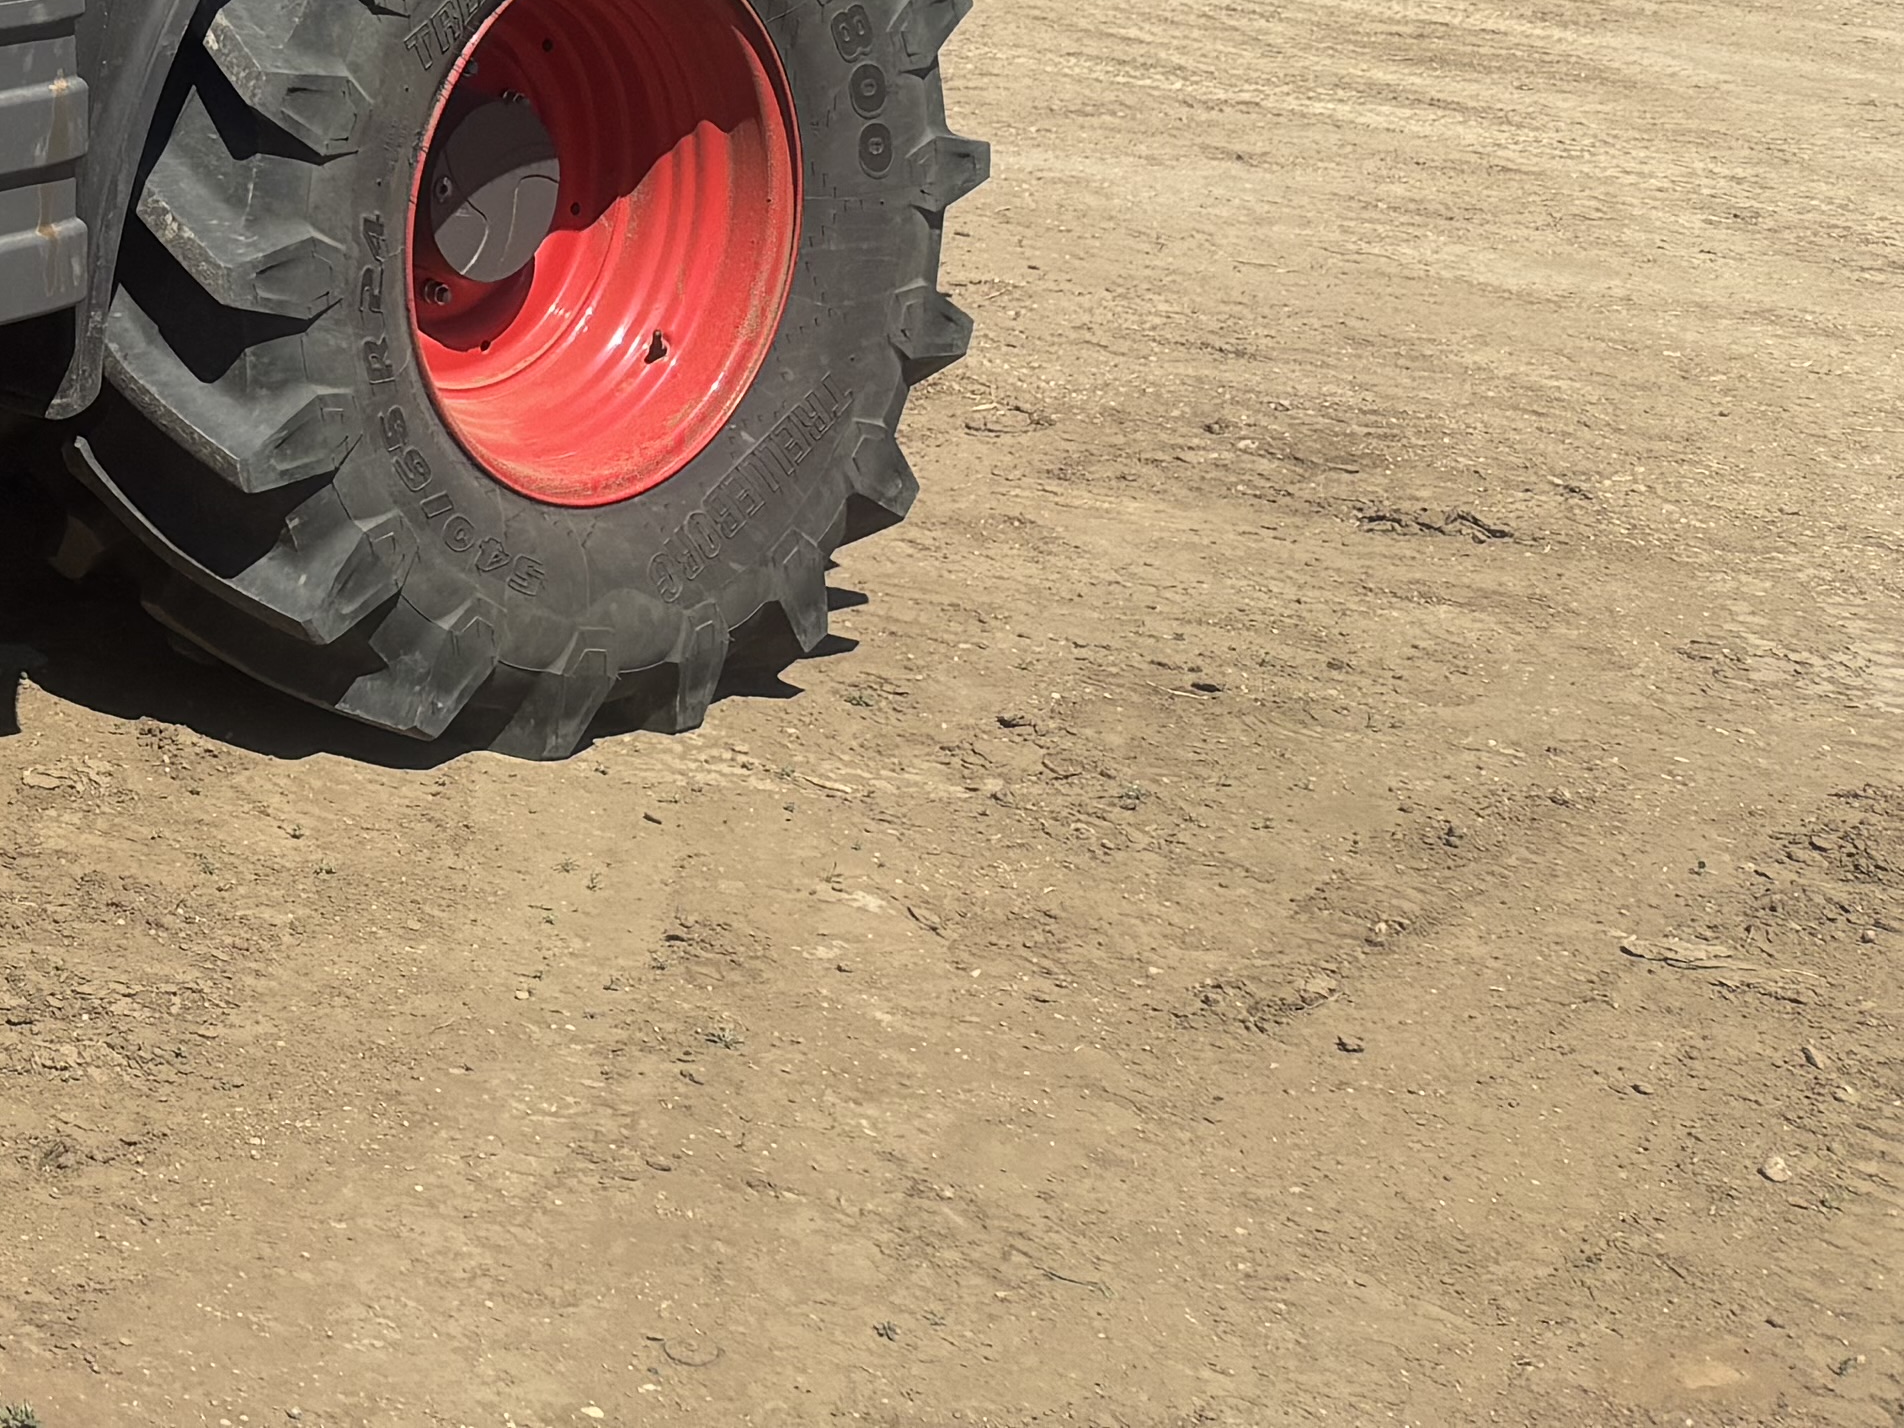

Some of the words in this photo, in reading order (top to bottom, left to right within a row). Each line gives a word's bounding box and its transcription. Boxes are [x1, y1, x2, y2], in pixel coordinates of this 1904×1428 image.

[357, 210, 387, 316] 24
[361, 332, 397, 387] R
[377, 404, 548, 597] 540/65
[646, 370, 856, 604] TRELLEBORG
